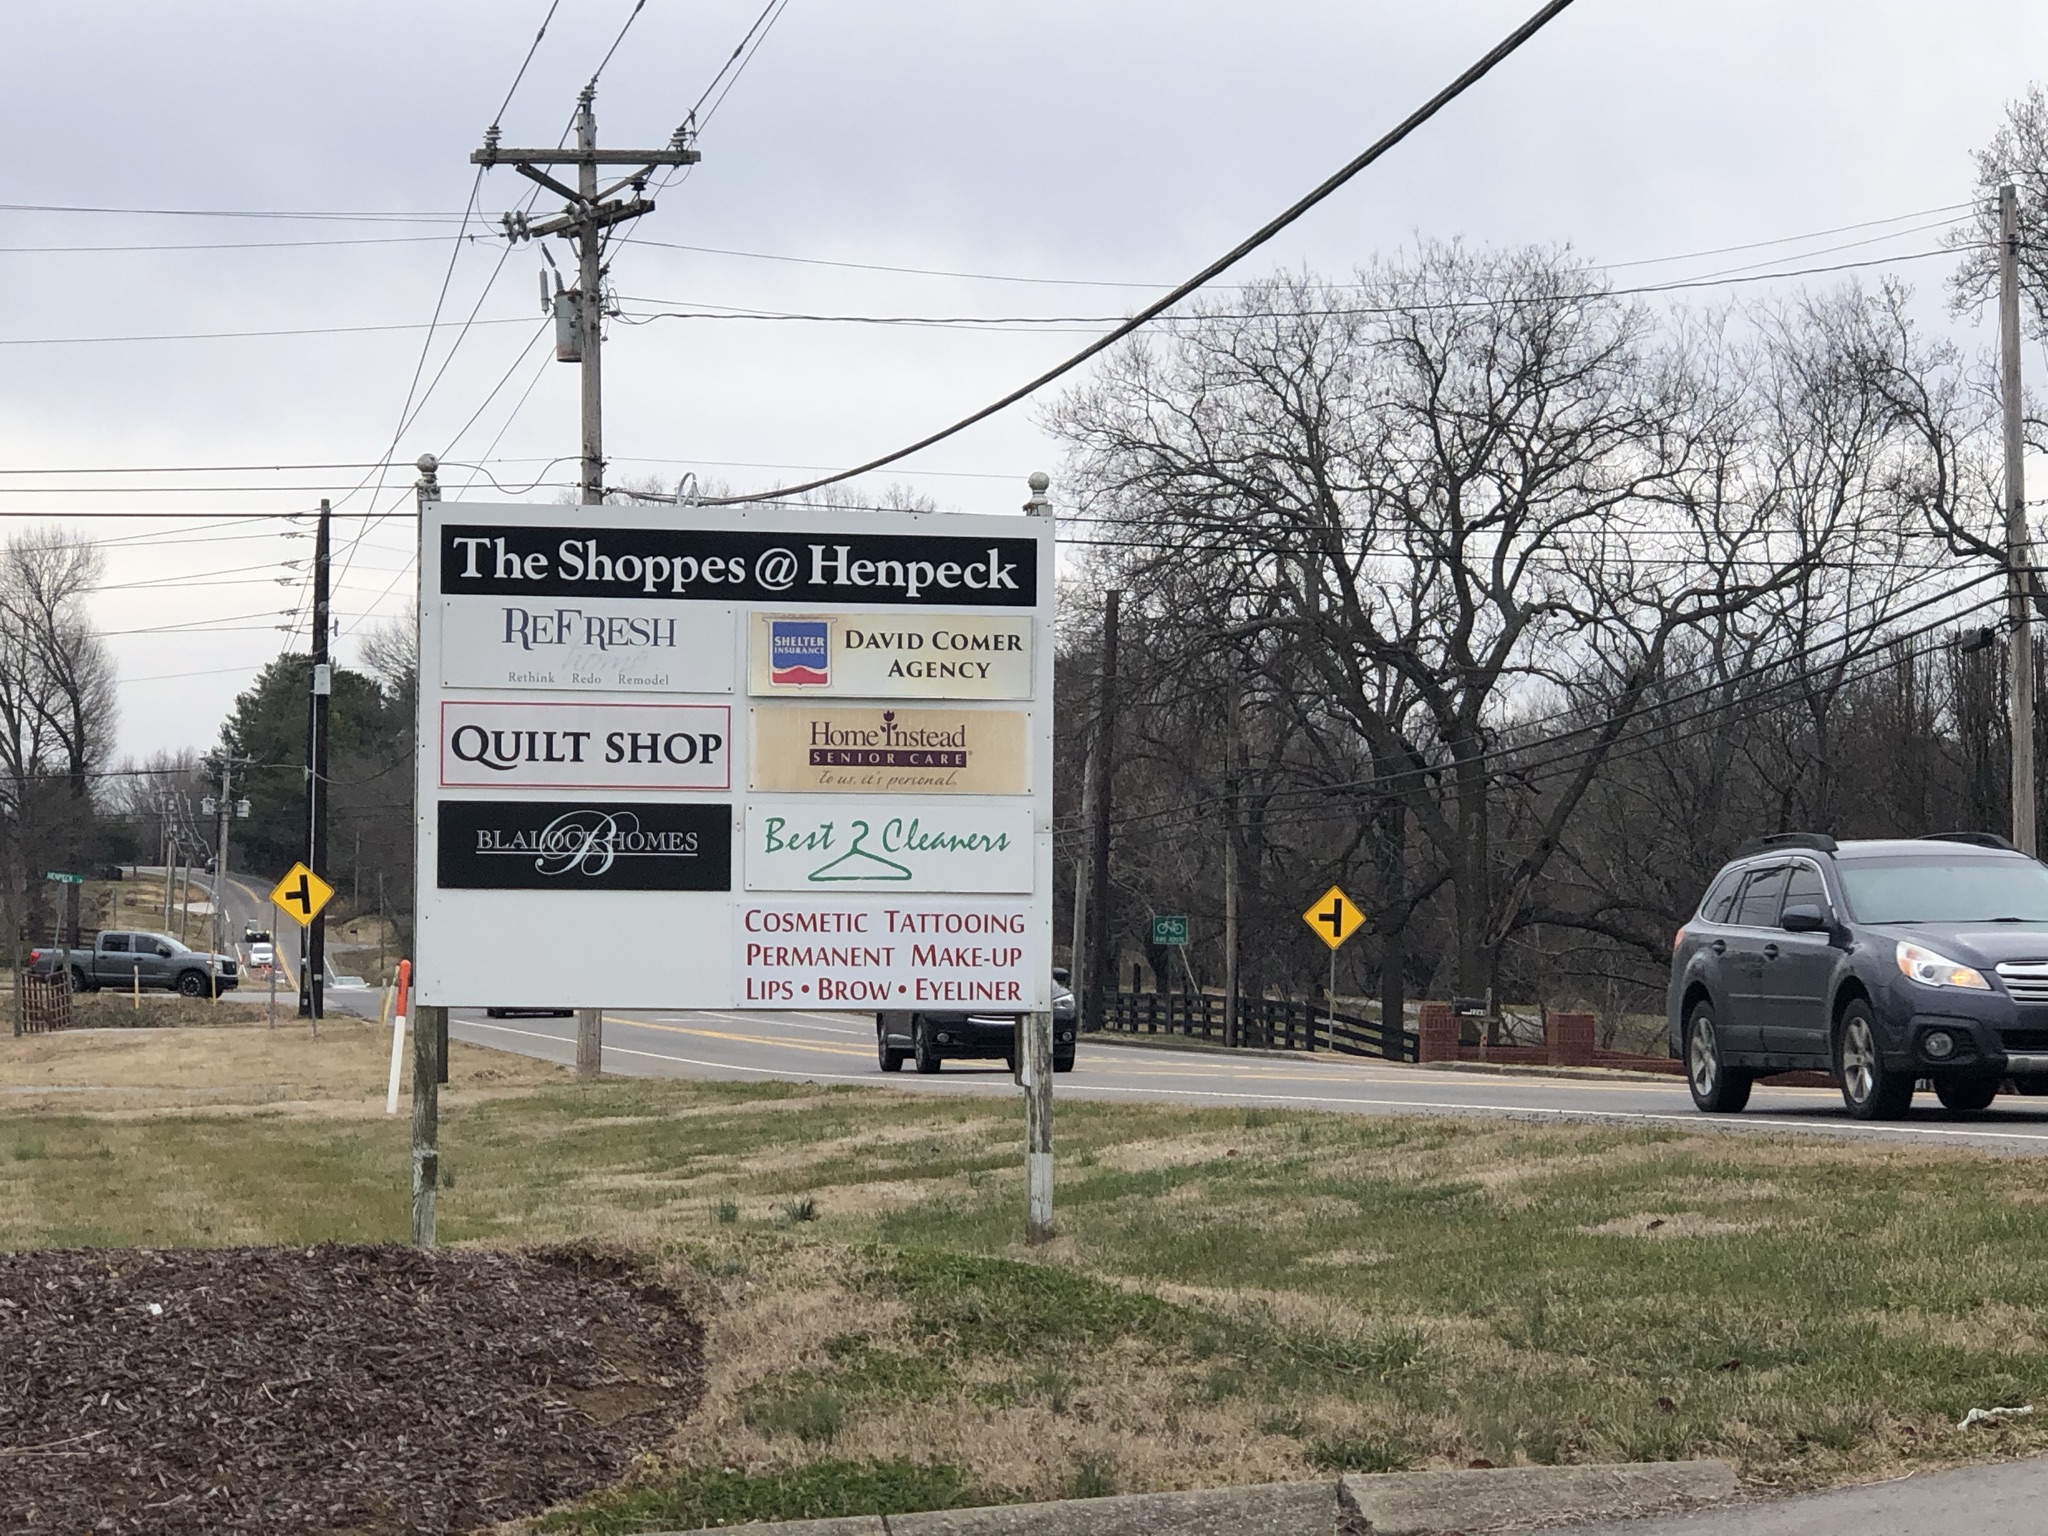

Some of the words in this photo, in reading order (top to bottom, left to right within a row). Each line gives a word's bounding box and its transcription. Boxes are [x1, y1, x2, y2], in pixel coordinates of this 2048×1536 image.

[453, 536, 548, 580] The
[558, 539, 745, 593] Shoppes
[754, 548, 799, 590] @
[808, 544, 1019, 597] Henpeck
[775, 636, 824, 646] SHELTER
[845, 630, 923, 649] DAVID
[932, 631, 1023, 651] COMER
[508, 672, 555, 683] Rethink
[572, 673, 601, 684] Redo
[618, 674, 669, 685] Remodel
[888, 660, 991, 678] AGENCY
[810, 721, 878, 746] Home
[885, 723, 965, 747] Instead
[451, 725, 590, 770] QUILT
[605, 732, 722, 764] SHOP
[813, 752, 895, 763] SENIOR
[910, 753, 962, 764] CARE
[861, 771, 881, 785] it's
[610, 832, 697, 851] HOMES
[765, 817, 836, 853] Best
[882, 818, 1010, 853] Cleaners
[745, 909, 868, 932] COSMETIC
[884, 910, 1025, 934] TATTOOING
[746, 943, 895, 967] PERMANENT
[911, 944, 1022, 967] MAKE-UP
[746, 977, 793, 1000] LIPS
[818, 978, 892, 1000] BROW
[915, 979, 1022, 1001] EYELINER
